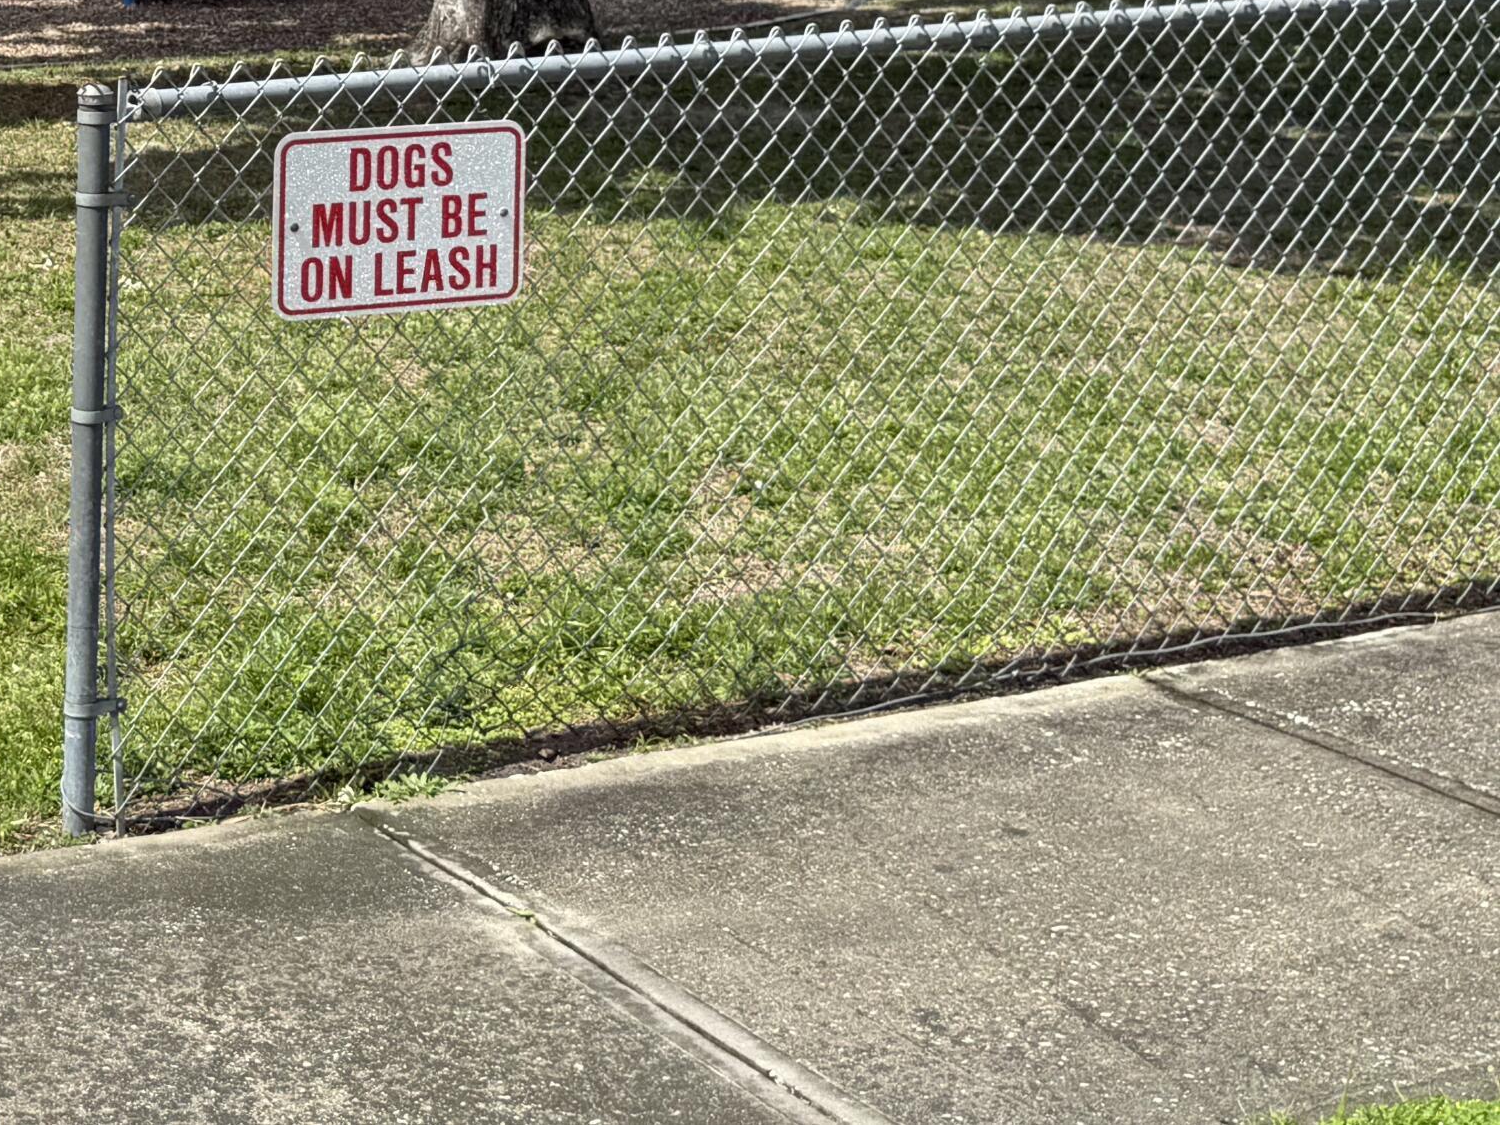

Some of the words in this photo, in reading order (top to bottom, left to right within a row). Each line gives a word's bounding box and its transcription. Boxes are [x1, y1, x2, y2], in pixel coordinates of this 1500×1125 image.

[350, 142, 453, 192] DOGS
[312, 197, 423, 248] MUST
[441, 192, 488, 238] BE
[301, 255, 353, 302] ON
[374, 244, 497, 296] LEASH
